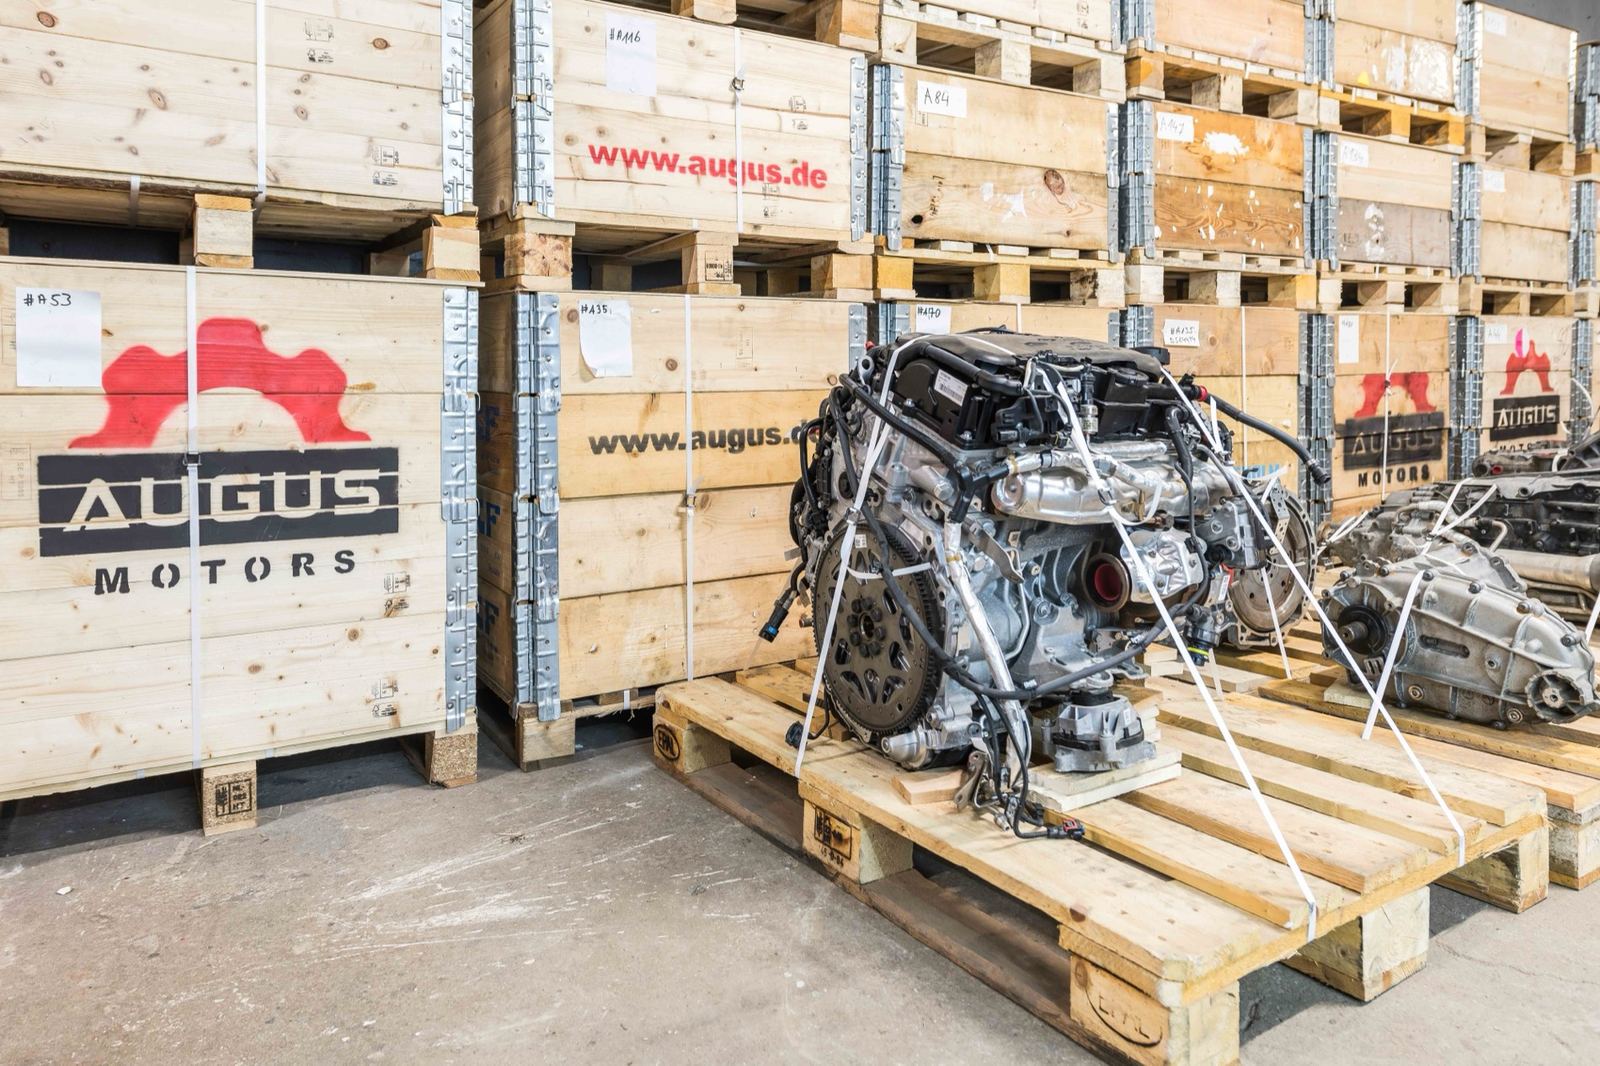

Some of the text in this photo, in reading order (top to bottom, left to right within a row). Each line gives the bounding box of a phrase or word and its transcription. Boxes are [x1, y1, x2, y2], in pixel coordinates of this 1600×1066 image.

[587, 143, 828, 190] www.augus.de
[24, 292, 71, 307] #A53
[1497, 404, 1557, 427] AUGUS
[1351, 425, 1438, 455] AUGUS
[1358, 463, 1430, 487] MOTORS
[63, 468, 381, 532] AUGUS
[94, 549, 356, 595] MOTORS
